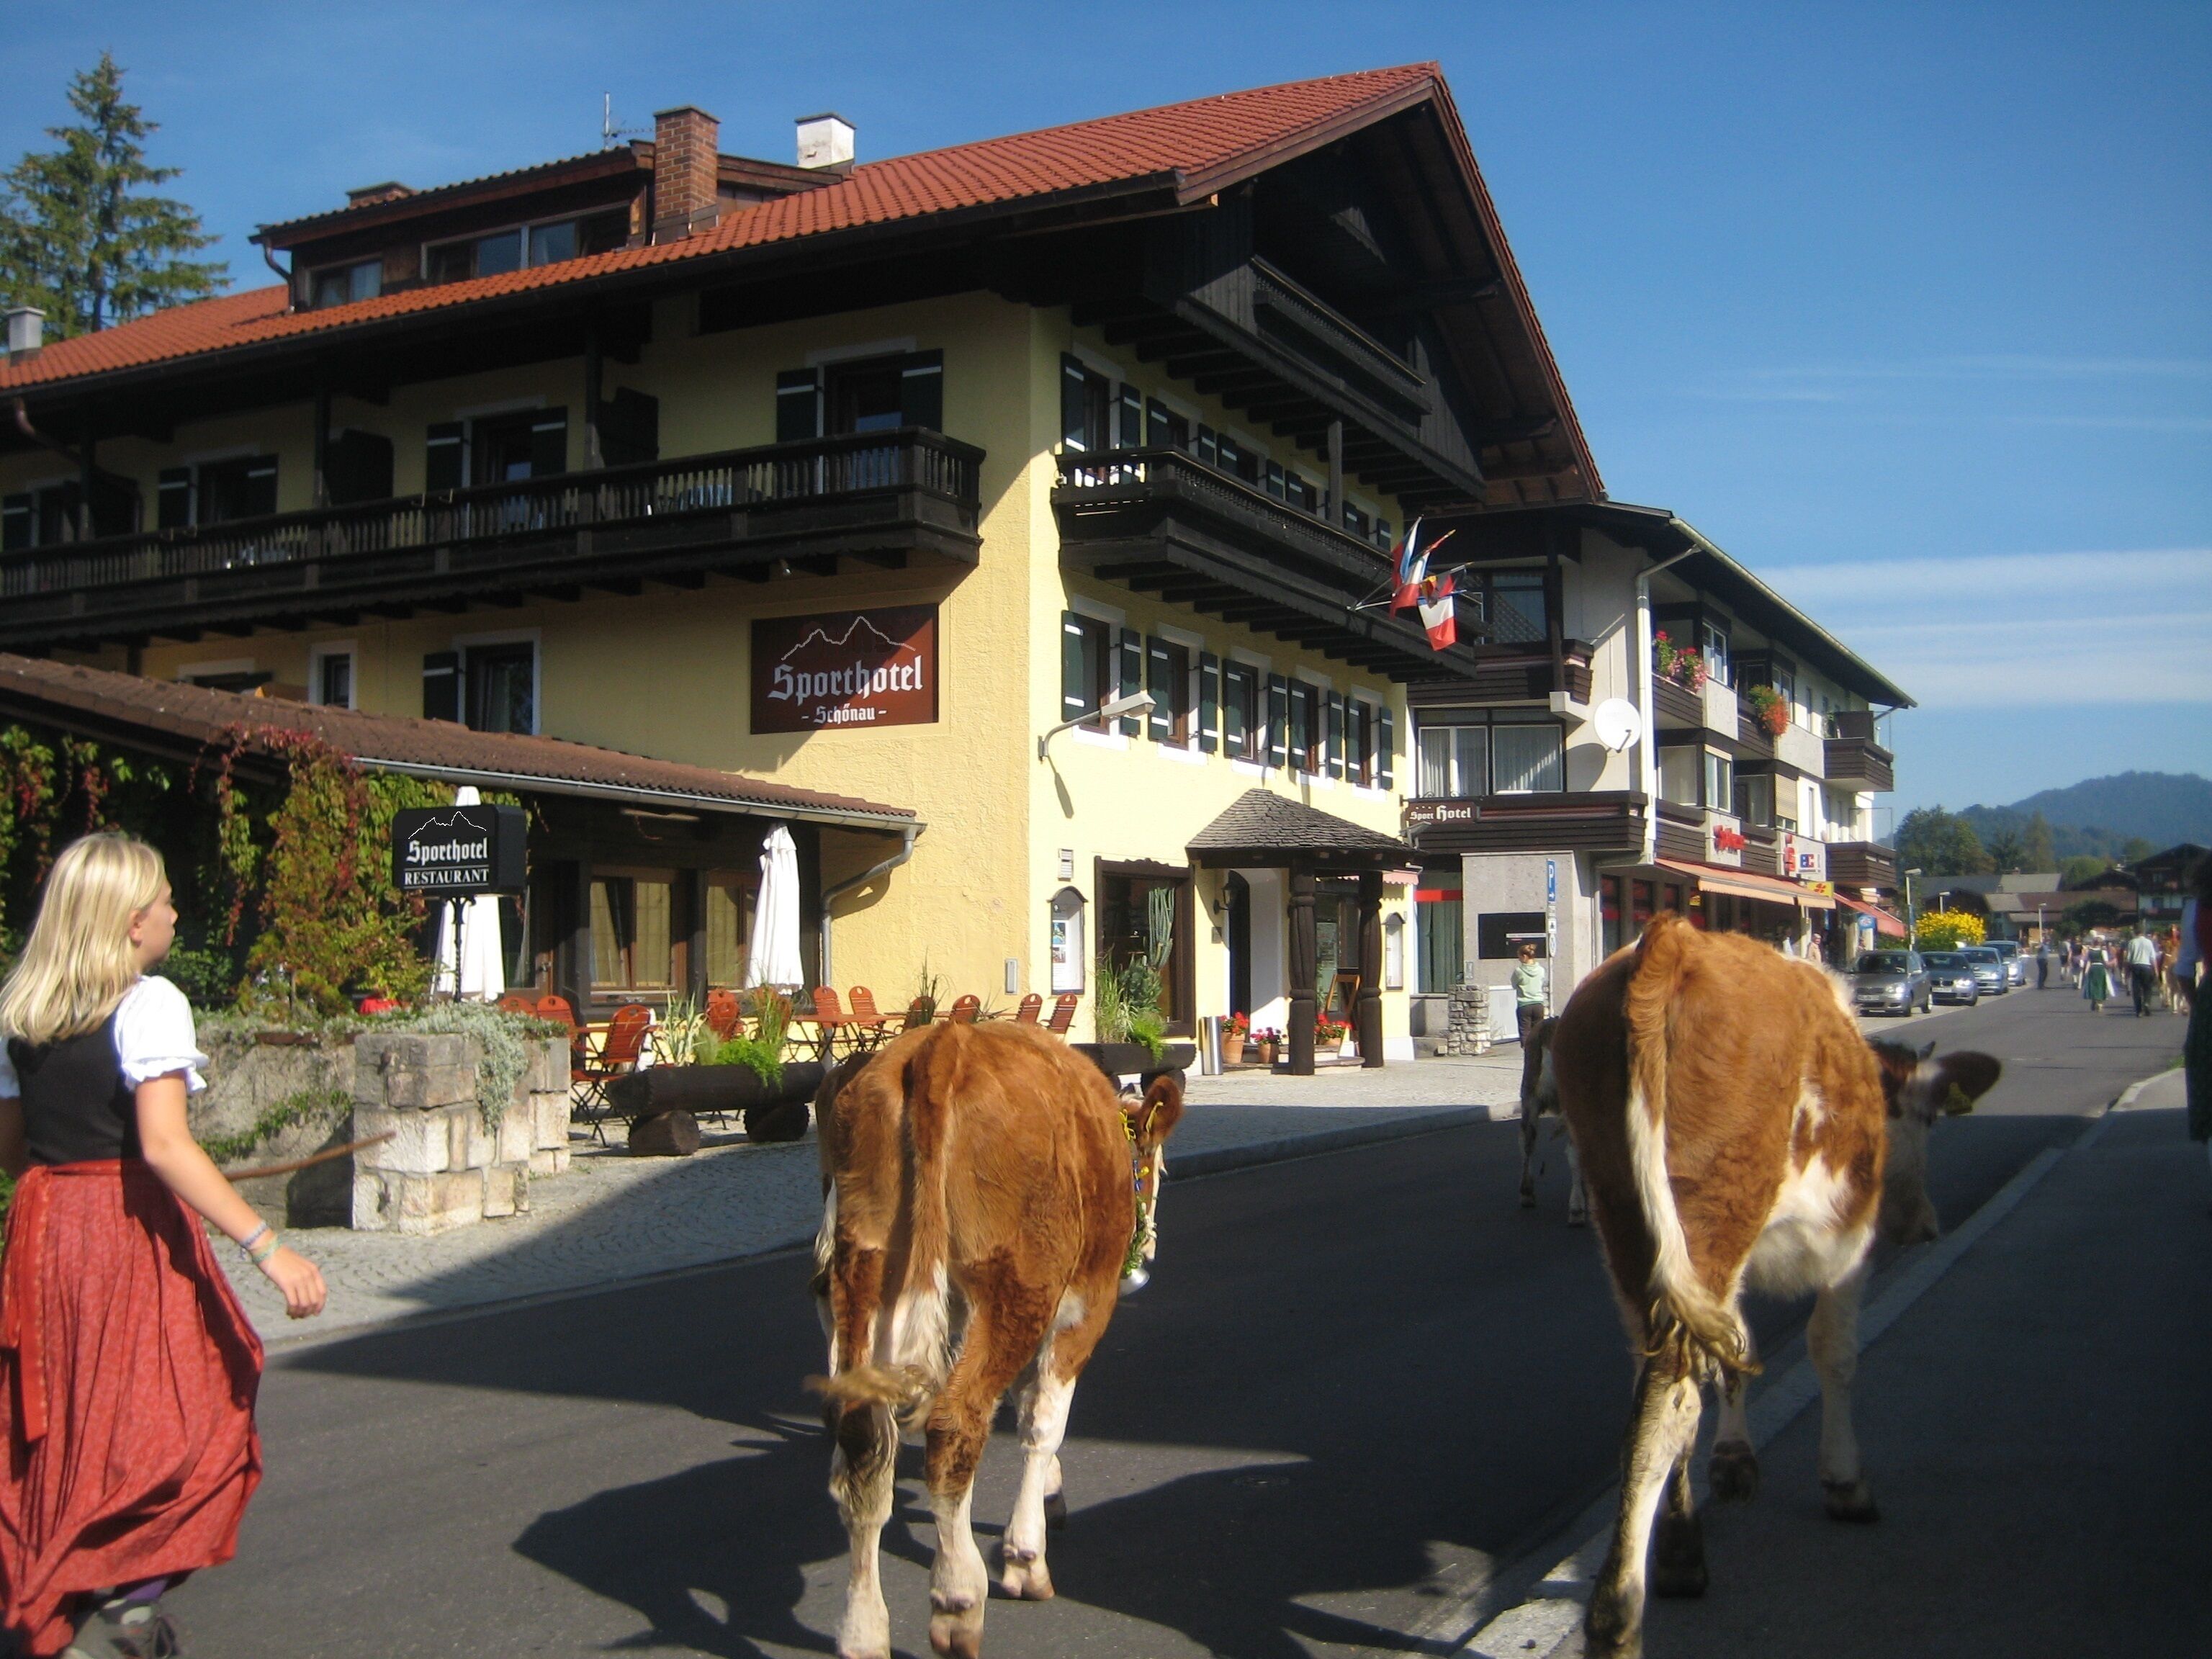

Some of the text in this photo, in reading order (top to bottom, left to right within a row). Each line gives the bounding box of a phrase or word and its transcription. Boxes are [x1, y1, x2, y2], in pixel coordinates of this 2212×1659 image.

[767, 655, 924, 707] Sporthotel
[814, 703, 876, 725] Schönau
[1409, 805, 1472, 822] Sport Hotel
[406, 837, 488, 866] Sporthotel
[405, 868, 489, 886] RESTAURANT
